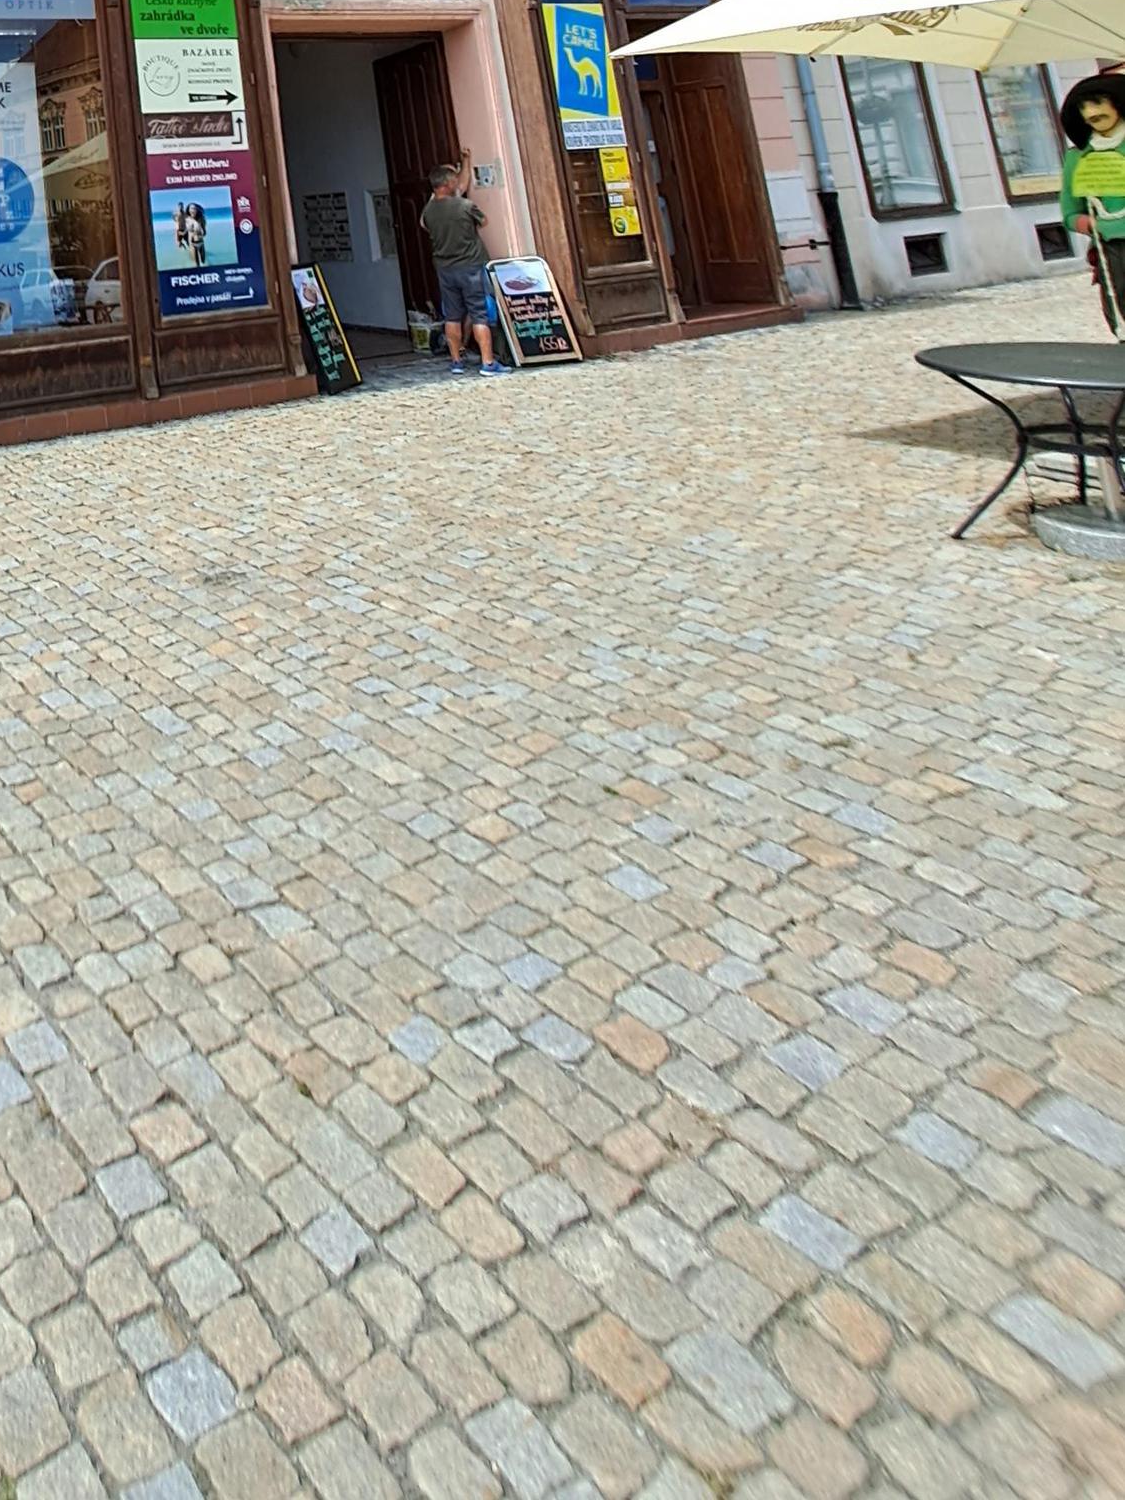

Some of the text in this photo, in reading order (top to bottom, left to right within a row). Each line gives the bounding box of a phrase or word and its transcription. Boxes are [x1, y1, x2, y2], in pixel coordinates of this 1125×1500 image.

[5, 0, 55, 11] OPTIK
[140, 9, 196, 21] zahrádka
[180, 23, 230, 35] ve dvoře
[565, 23, 598, 39] LET'S
[562, 35, 601, 51] CAMEL
[182, 47, 233, 57] BAZÁREK
[170, 272, 221, 288] FISCHER
